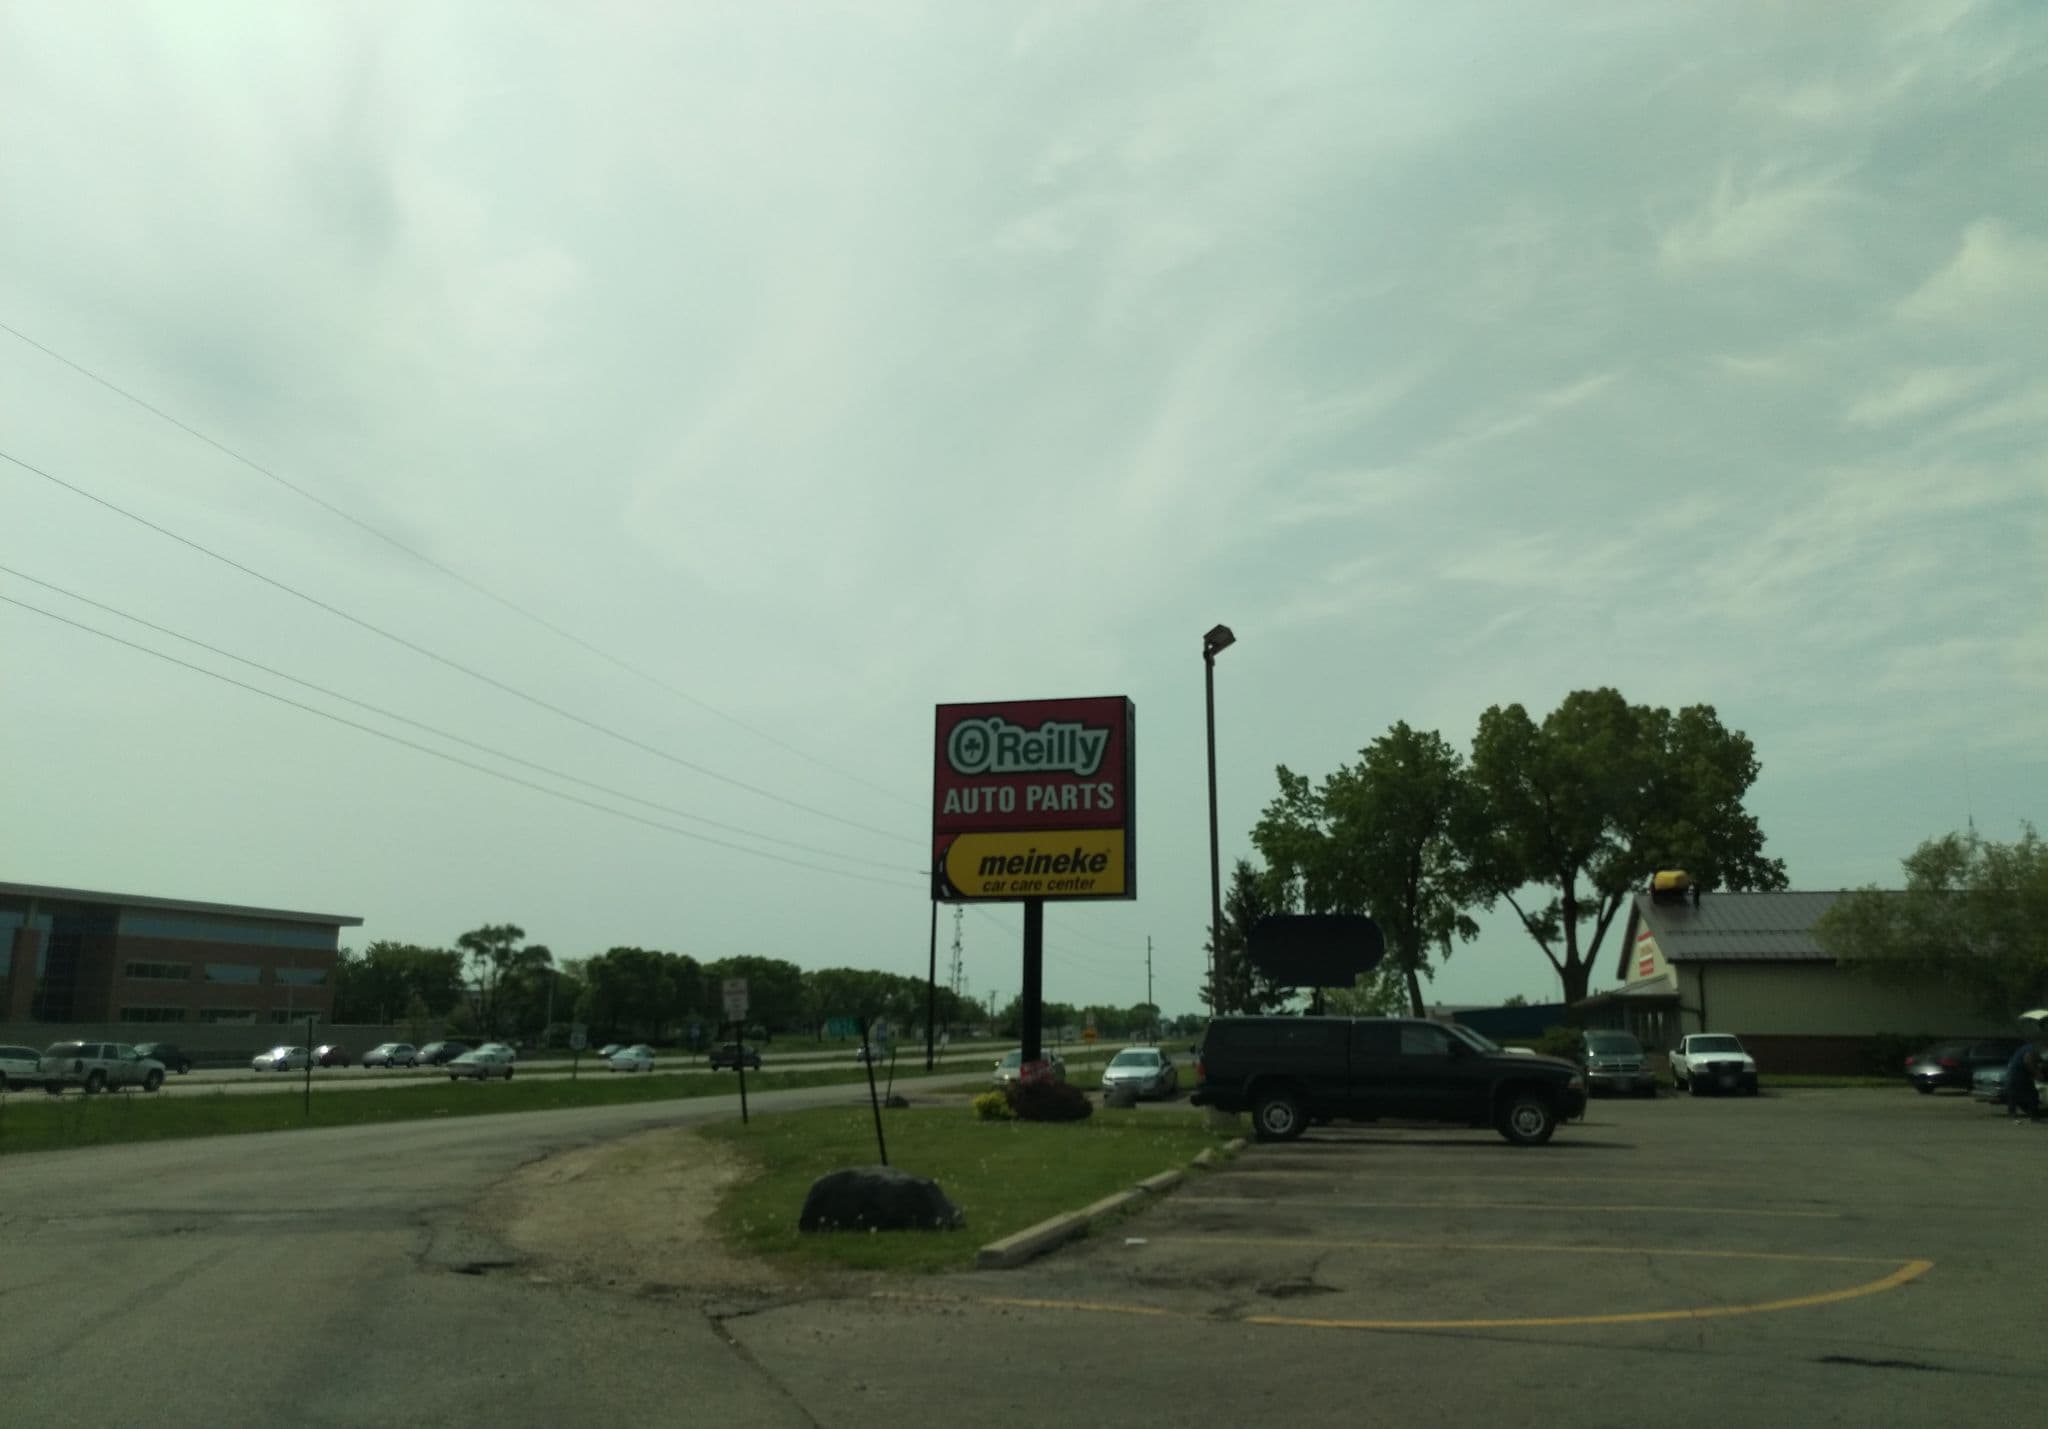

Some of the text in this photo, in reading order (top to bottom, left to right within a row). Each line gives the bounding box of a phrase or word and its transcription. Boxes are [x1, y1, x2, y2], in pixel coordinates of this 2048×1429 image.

[949, 717, 1108, 776] O'Reilly
[943, 783, 1115, 814] AUTO PARTS
[978, 848, 1108, 876] meineke
[983, 878, 1095, 892] car care center
